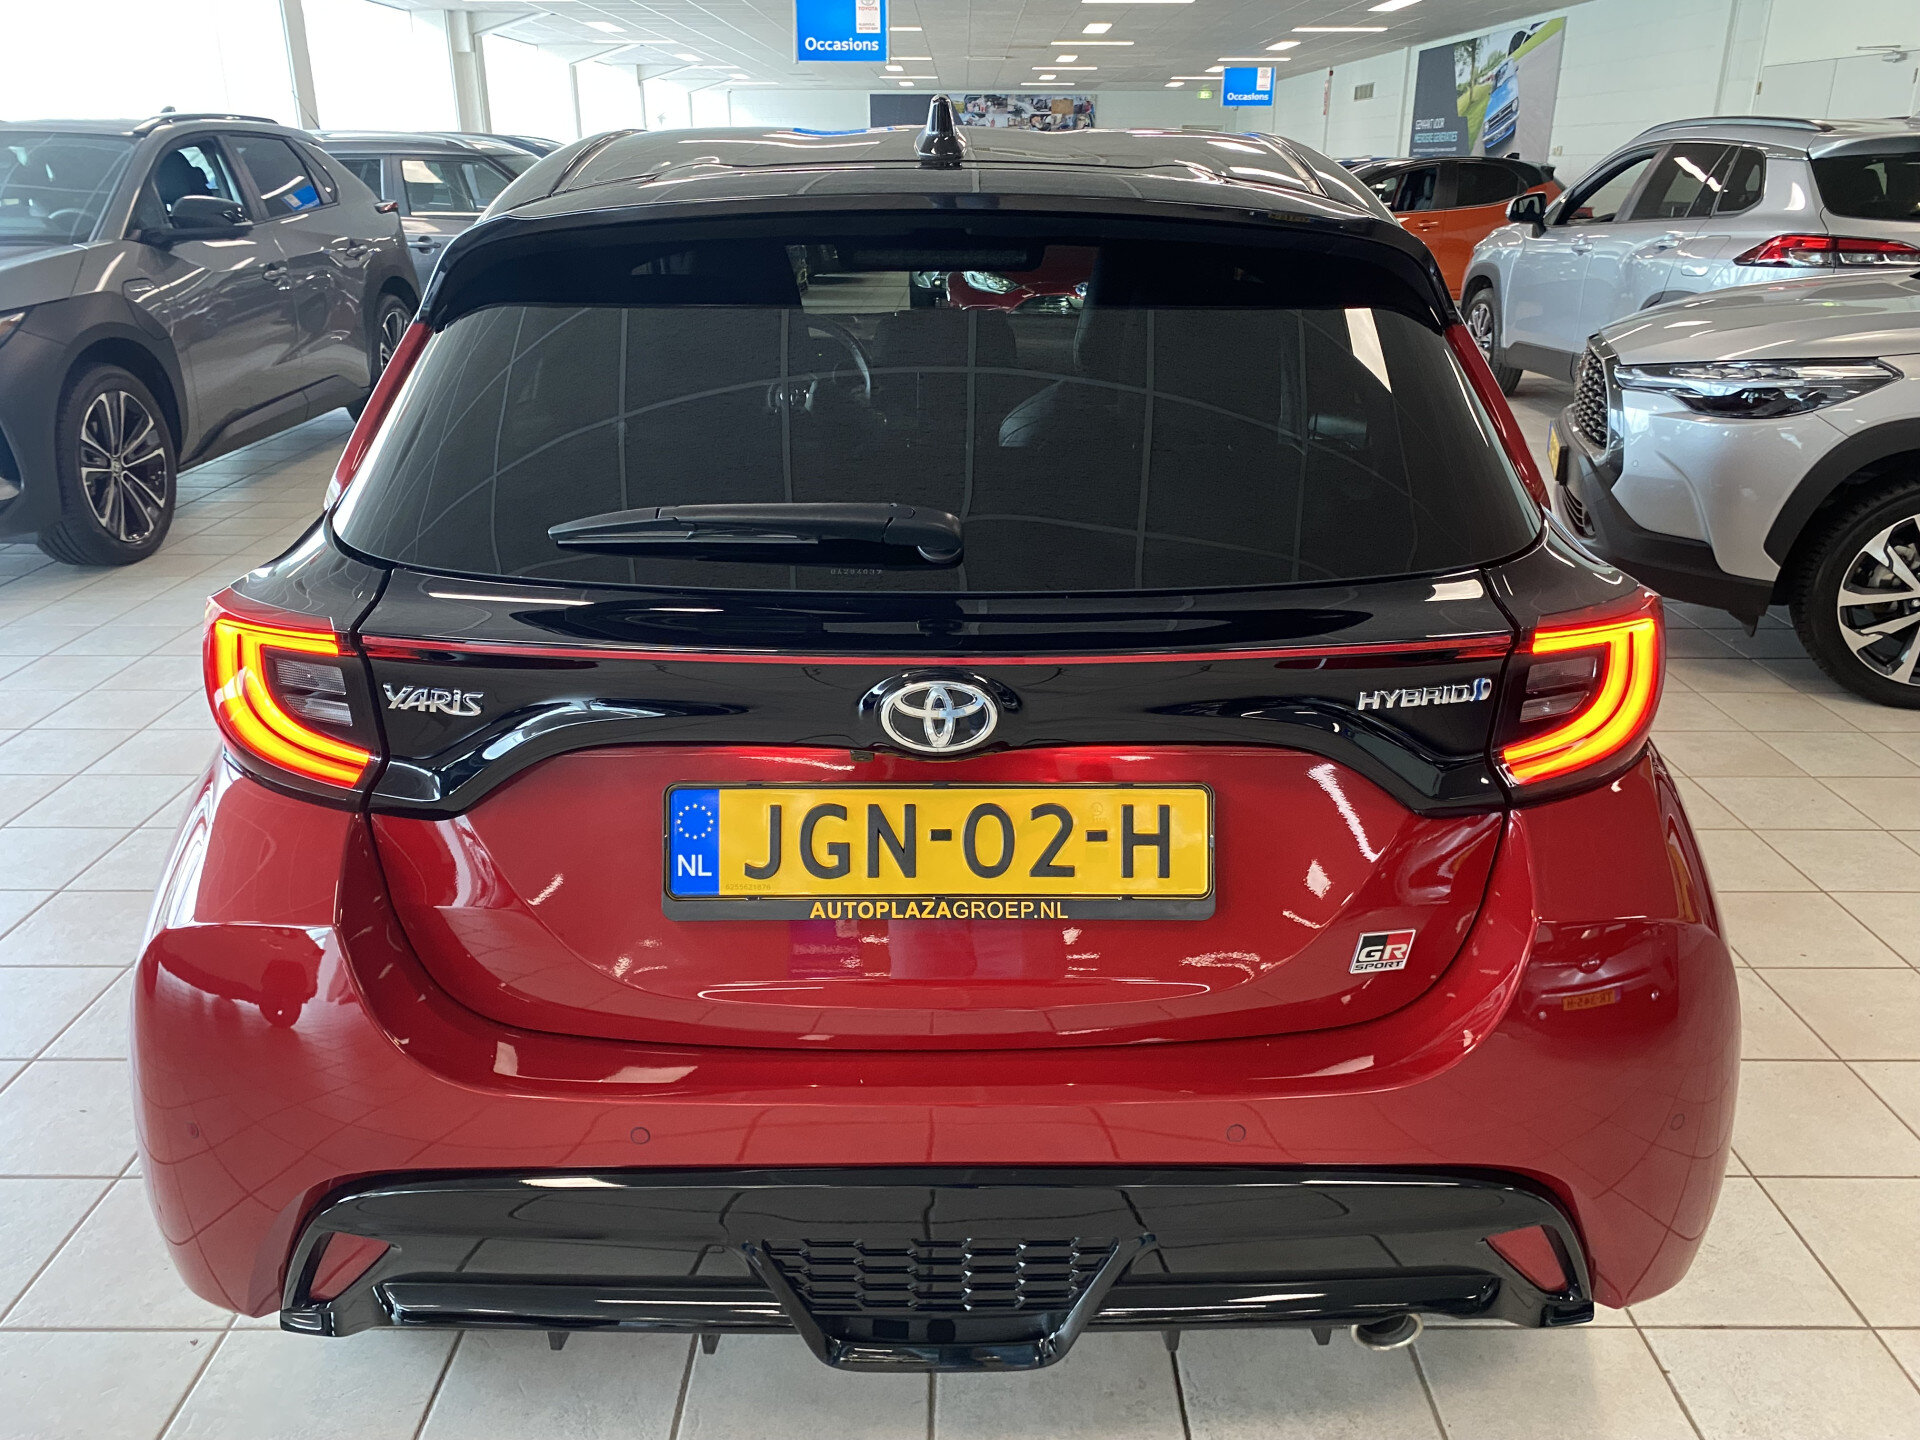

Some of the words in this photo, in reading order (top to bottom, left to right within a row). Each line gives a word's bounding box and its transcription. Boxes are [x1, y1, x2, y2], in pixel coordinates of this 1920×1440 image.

[804, 37, 880, 51] Occasions
[1227, 92, 1269, 101] Occasions
[383, 683, 484, 716] YARIS
[1358, 684, 1471, 711] HYBRID
[744, 803, 1171, 880] JGN-02-H
[677, 854, 712, 877] NL
[809, 901, 1069, 920] AUTOPLAZAGROEP.NL
[1358, 943, 1408, 962] GR
[1354, 960, 1404, 971] SPORT
